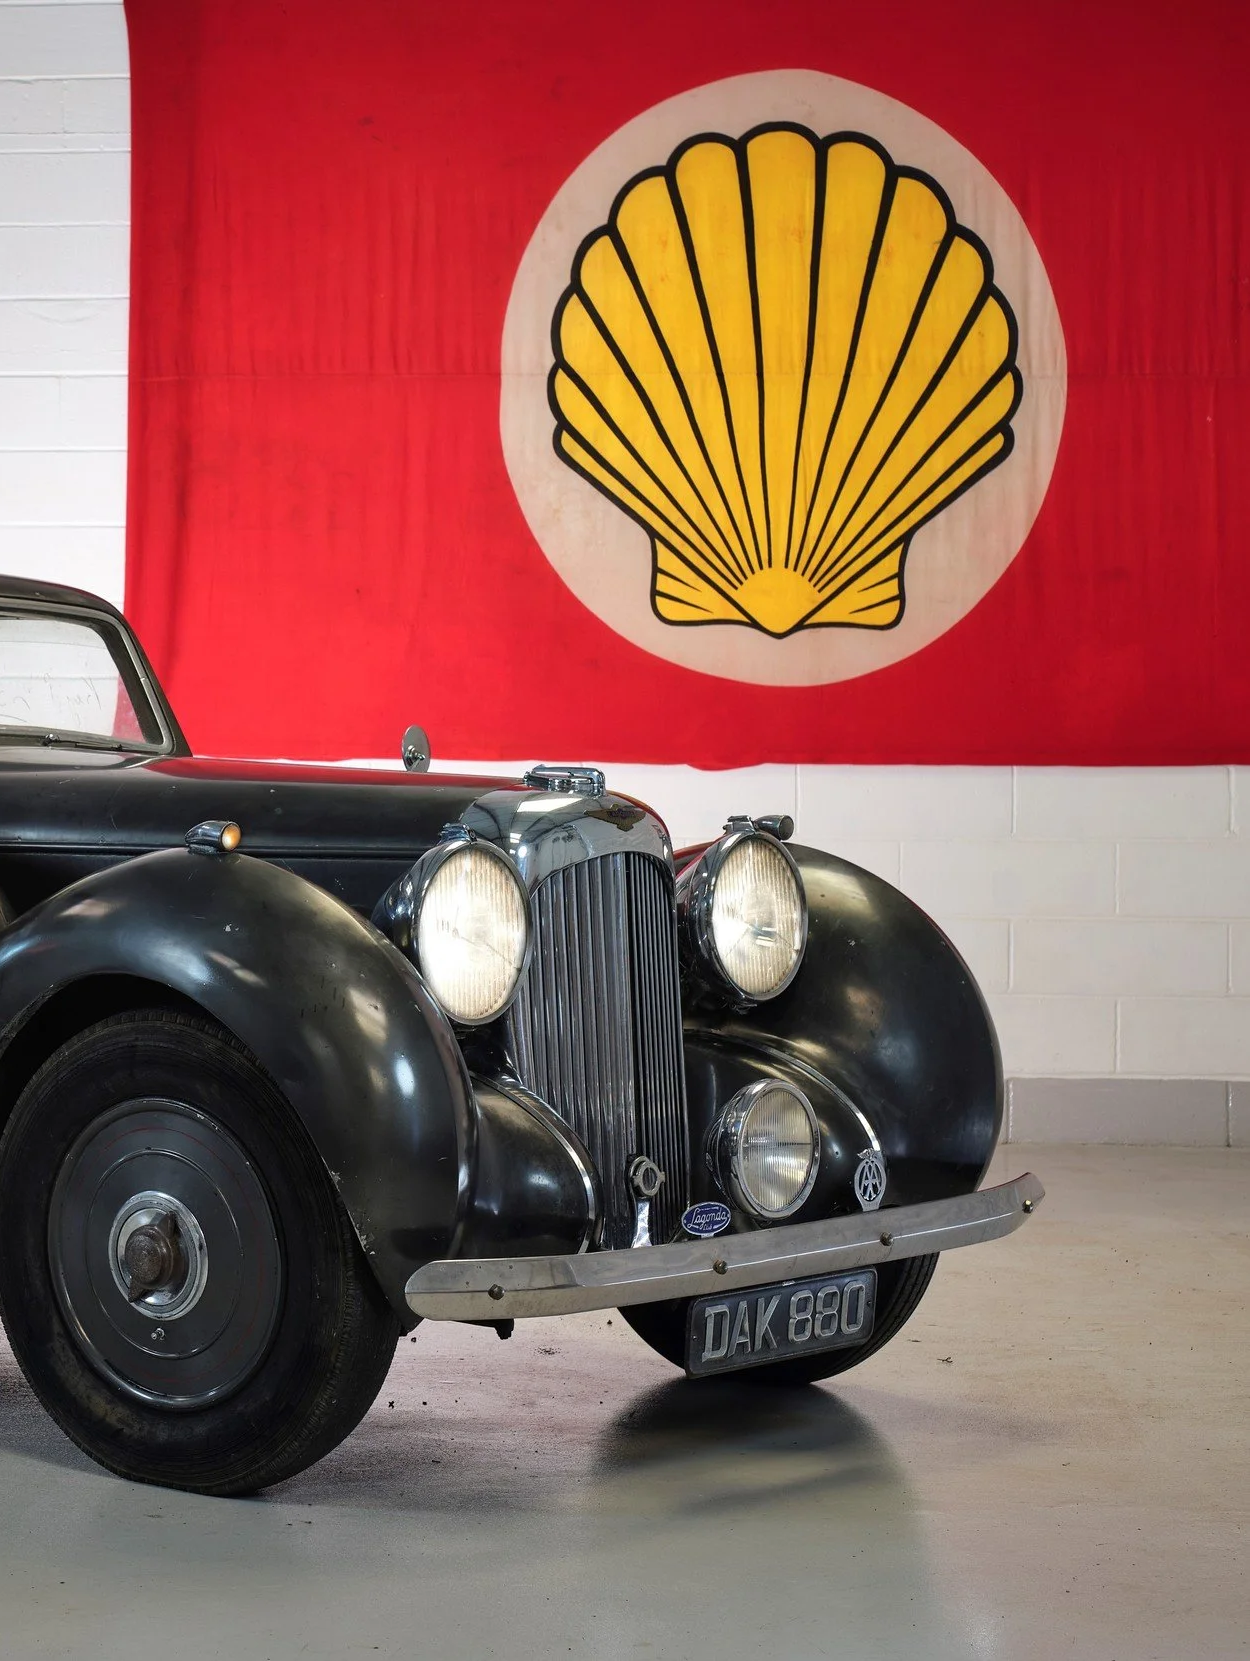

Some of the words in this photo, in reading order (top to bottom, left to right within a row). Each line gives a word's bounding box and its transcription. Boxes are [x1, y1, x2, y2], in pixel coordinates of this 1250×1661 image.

[687, 1206, 728, 1230] Lagonda
[702, 1294, 782, 1363] DAK
[788, 1280, 866, 1344] 880
